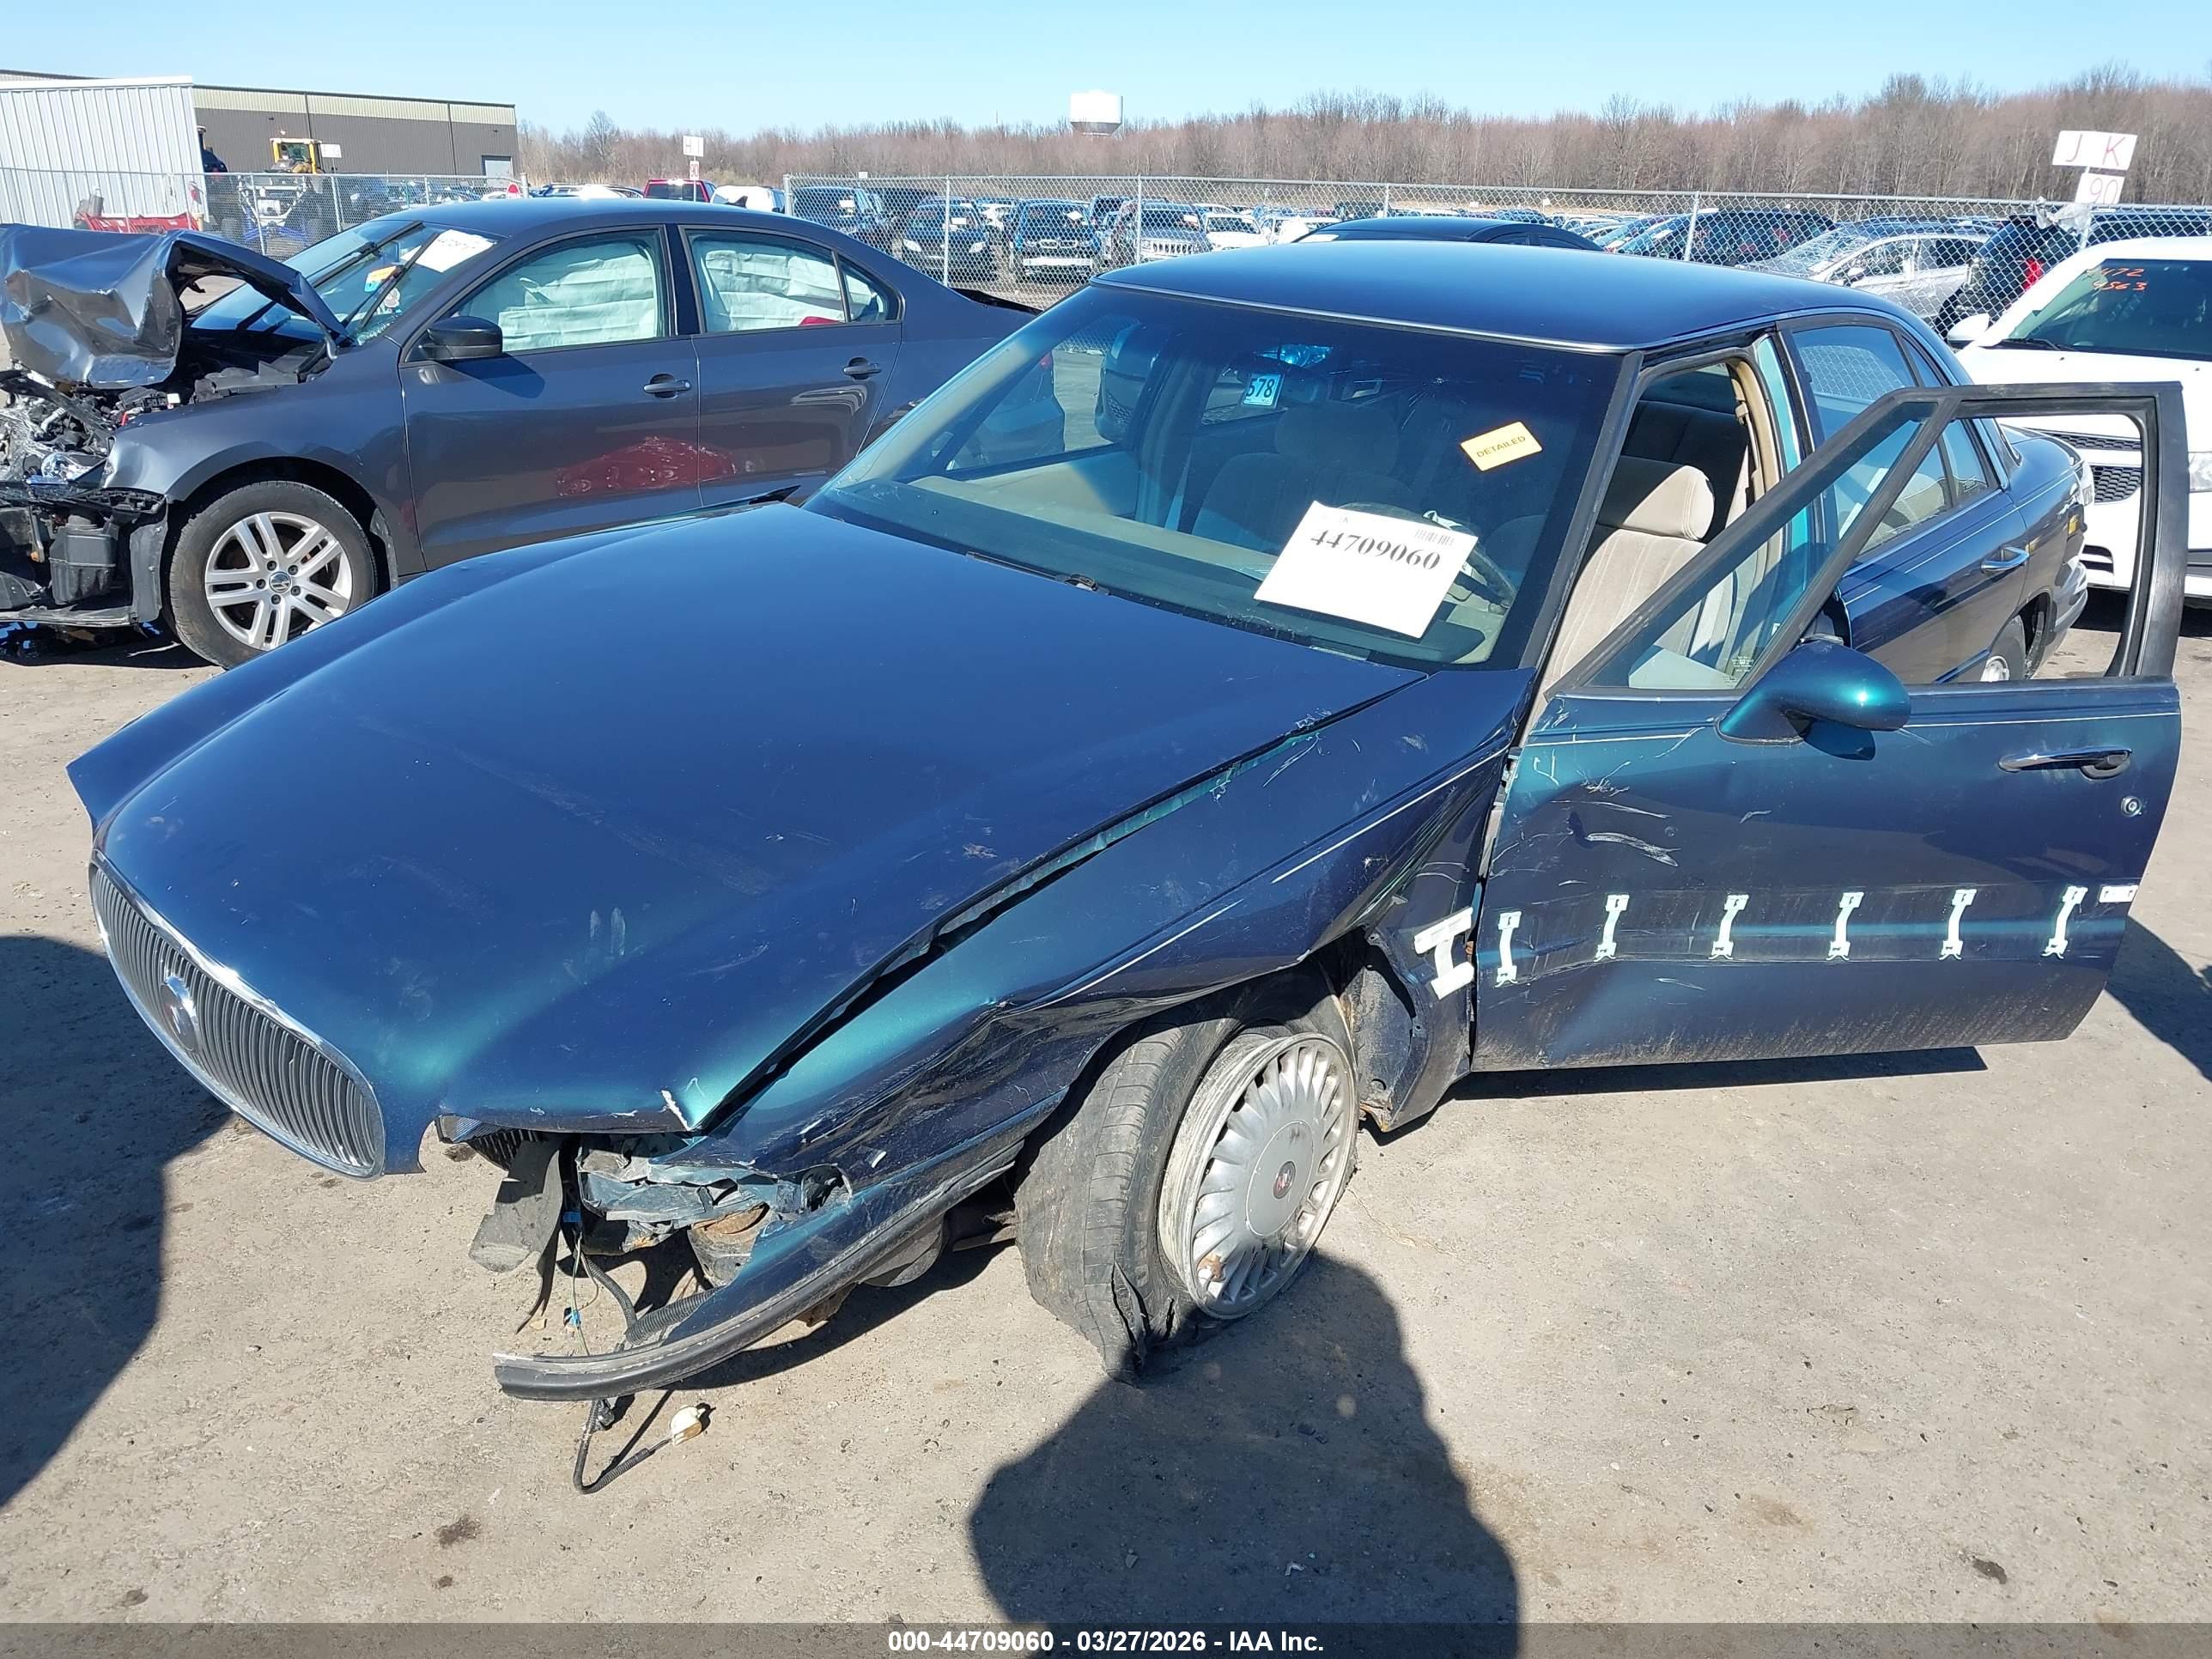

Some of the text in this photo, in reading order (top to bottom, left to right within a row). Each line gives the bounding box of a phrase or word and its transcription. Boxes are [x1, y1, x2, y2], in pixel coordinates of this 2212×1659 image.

[2064, 133, 2126, 167] J K
[2089, 177, 2118, 204] 90
[1475, 434, 1527, 459] DETAILED
[1310, 528, 1442, 570] 44709060
